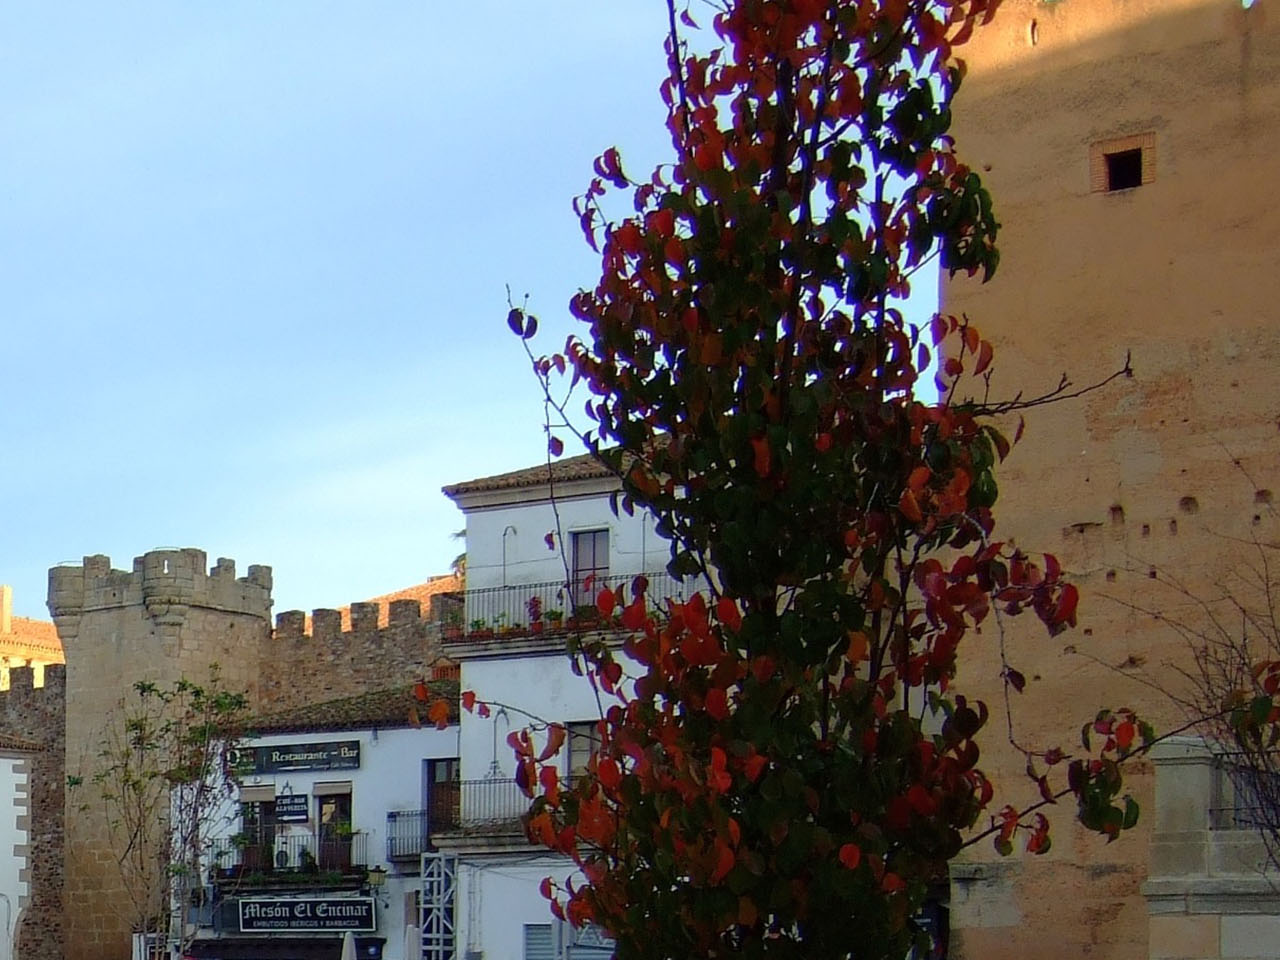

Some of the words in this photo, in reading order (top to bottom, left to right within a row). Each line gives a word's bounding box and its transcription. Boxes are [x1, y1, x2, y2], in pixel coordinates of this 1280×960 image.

[272, 751, 328, 762] Restaurante
[341, 747, 358, 758] Bar
[243, 902, 290, 919] Mesón
[294, 902, 312, 918] El
[316, 902, 369, 917] Encinar
[253, 920, 289, 928] EMBUTIDOS
[325, 919, 360, 927] BARBACOA
